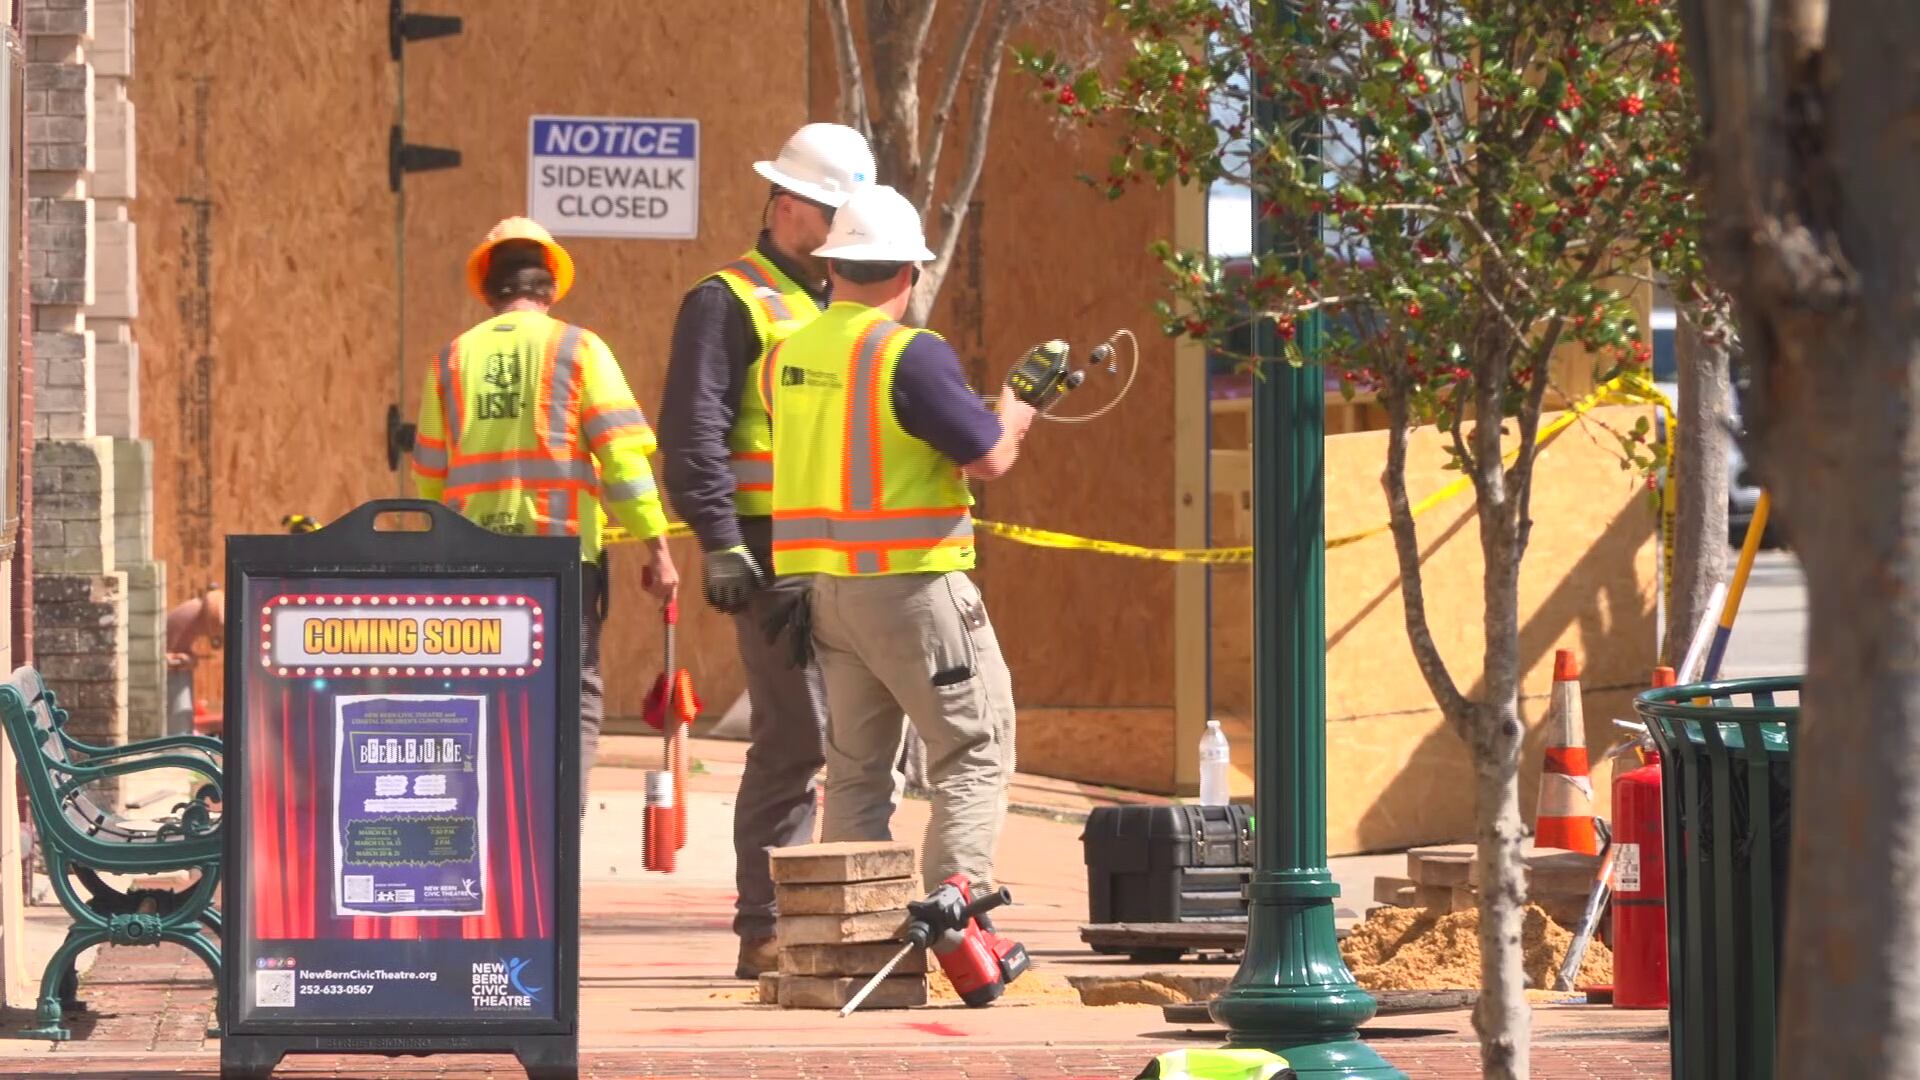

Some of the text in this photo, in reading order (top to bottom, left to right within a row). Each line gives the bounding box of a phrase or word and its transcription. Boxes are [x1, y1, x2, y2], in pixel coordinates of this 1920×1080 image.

[545, 124, 683, 155] NOTICE
[541, 164, 686, 190] SIDEWALK
[556, 194, 669, 219] CLOSED
[303, 617, 503, 655] COMING SOON
[472, 963, 506, 974] NEW
[299, 970, 438, 982] NewBernCivicTheatre.org
[472, 974, 509, 985] BERN
[300, 985, 374, 995] 252-633-0567
[472, 985, 508, 996] CIVIC
[472, 996, 531, 1006] THEATRE
